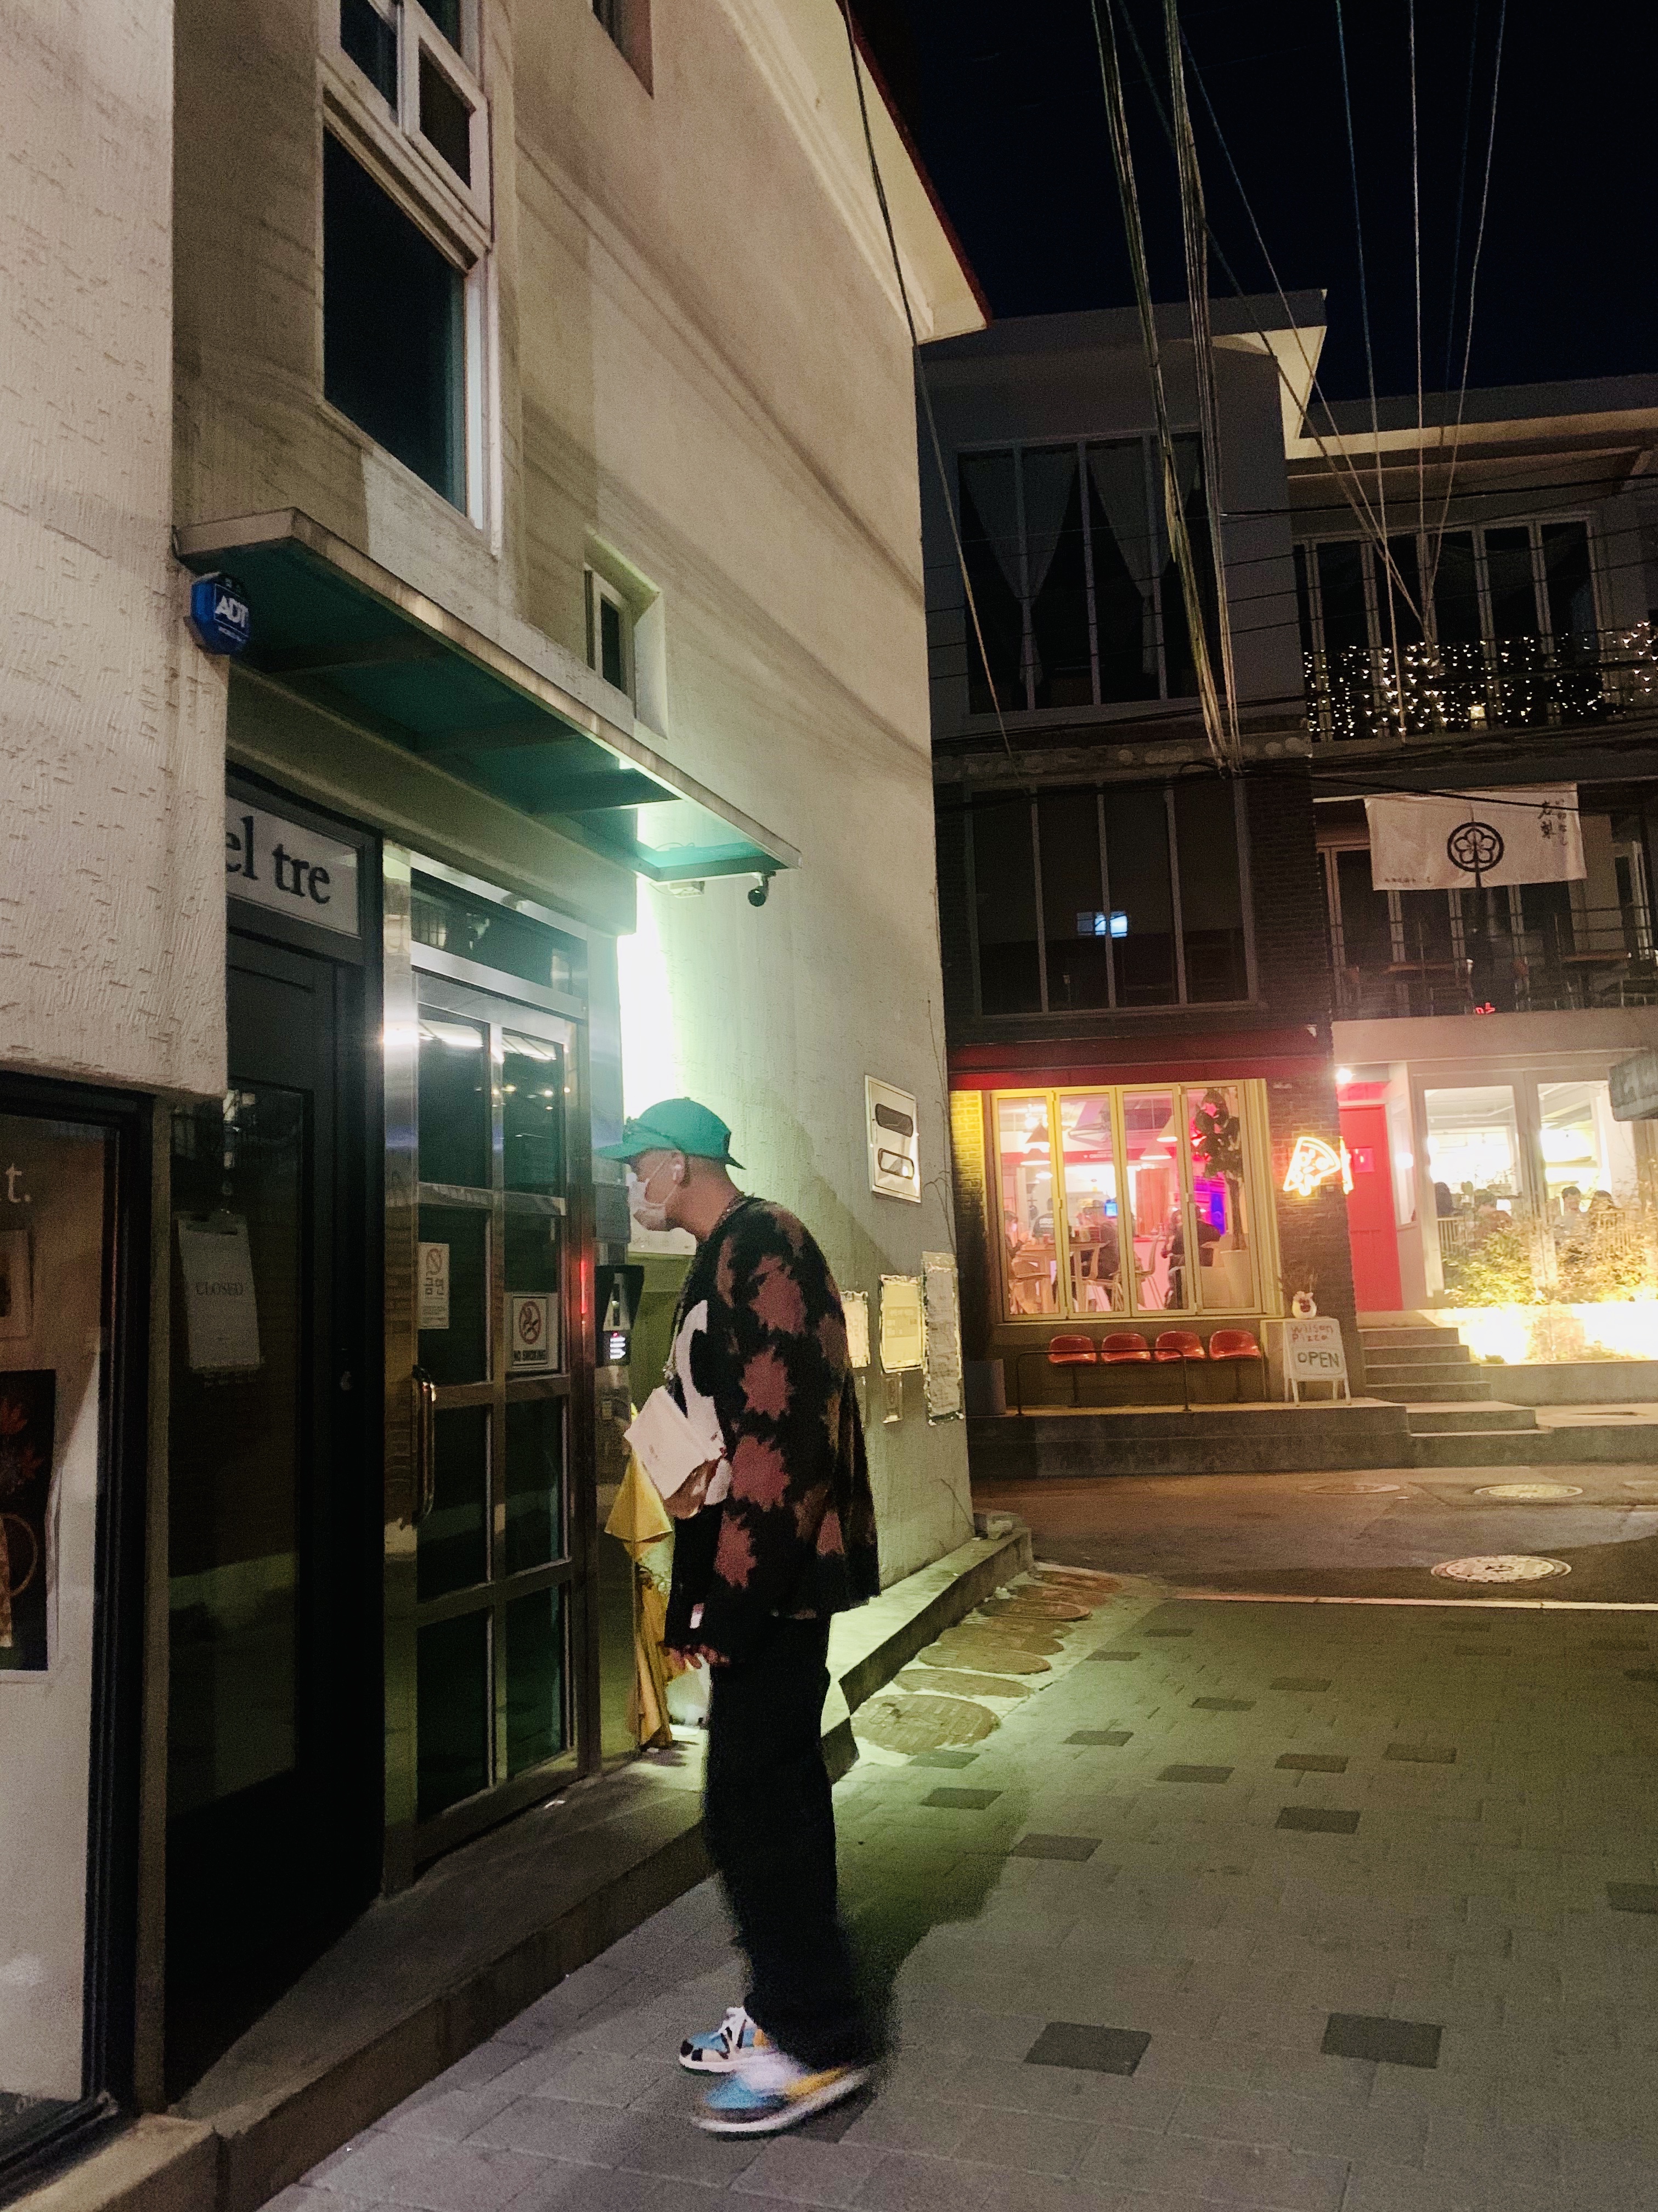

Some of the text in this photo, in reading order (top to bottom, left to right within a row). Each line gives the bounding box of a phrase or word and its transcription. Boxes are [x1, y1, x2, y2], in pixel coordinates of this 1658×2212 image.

[215, 595, 249, 628] ADT
[272, 844, 330, 904] tre
[195, 1281, 244, 1295] CLOSED
[1297, 1351, 1340, 1368] OPEN
